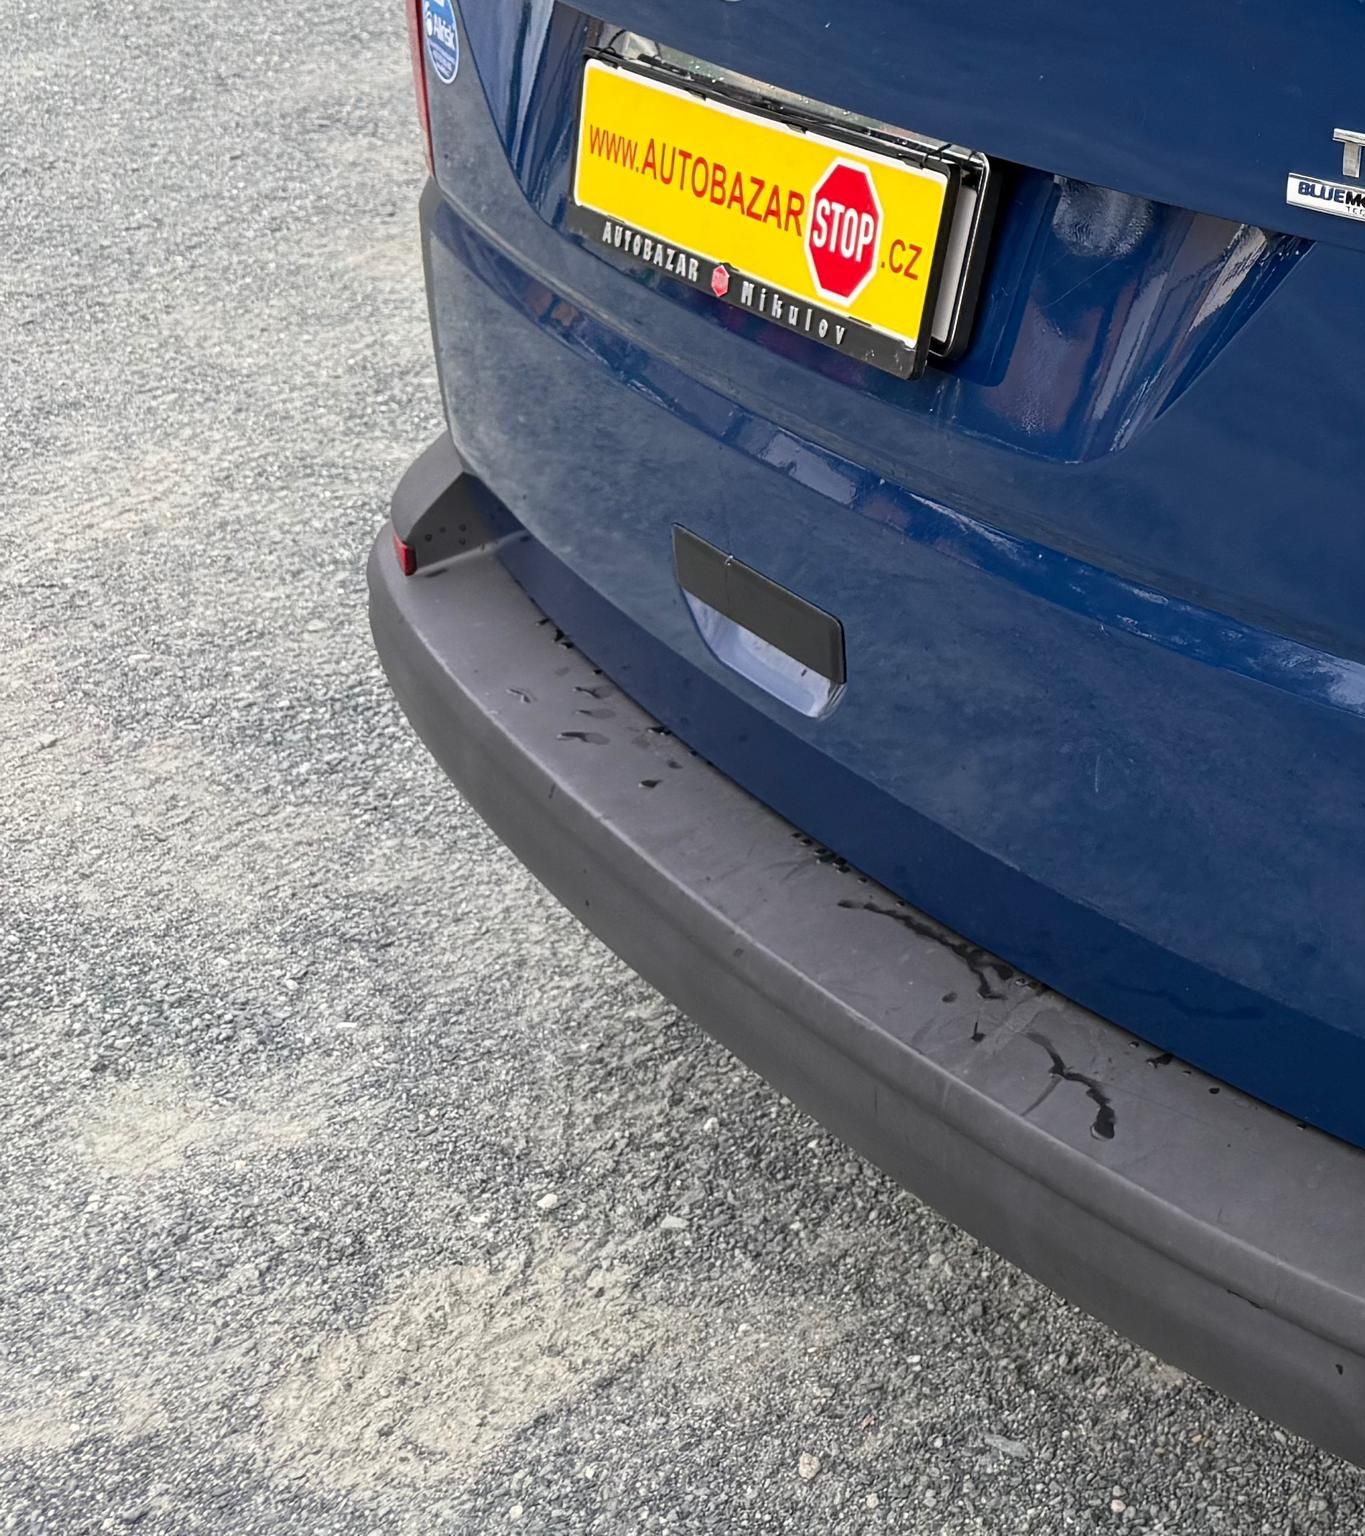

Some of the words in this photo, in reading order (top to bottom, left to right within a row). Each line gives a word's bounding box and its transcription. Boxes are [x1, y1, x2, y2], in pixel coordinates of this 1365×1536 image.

[812, 197, 875, 264] STOP
[602, 221, 699, 283] AUTOBAZAR
[741, 280, 847, 345] Mikulov
